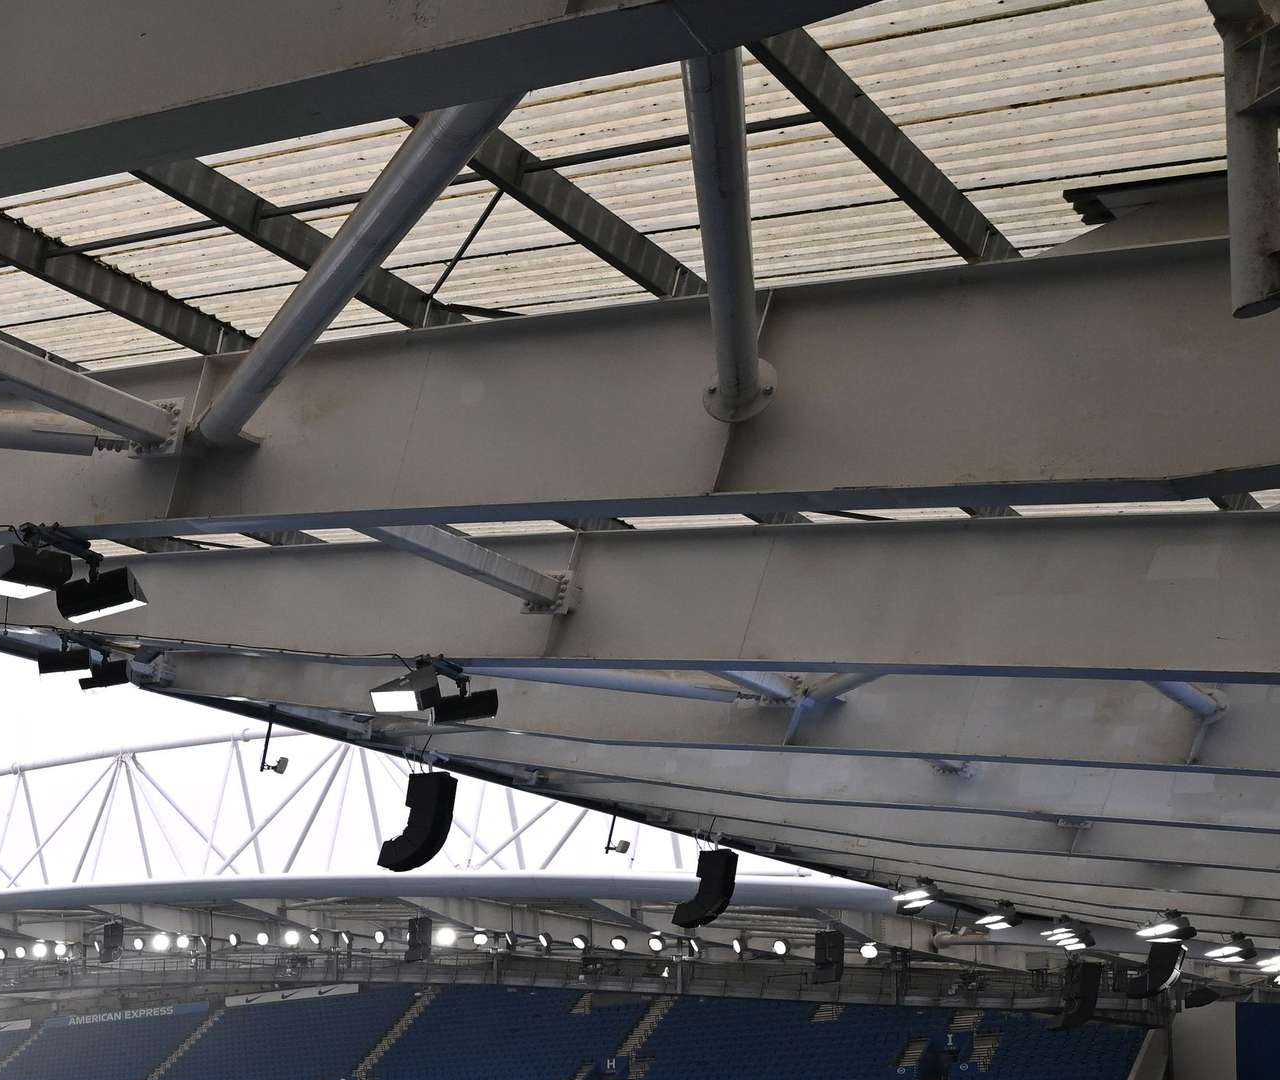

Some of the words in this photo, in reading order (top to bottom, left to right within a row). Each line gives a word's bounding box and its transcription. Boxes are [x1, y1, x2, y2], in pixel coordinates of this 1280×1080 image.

[69, 1011, 122, 1026] AMERICAN
[125, 1006, 174, 1020] EXPRESS
[607, 1058, 616, 1069] H
